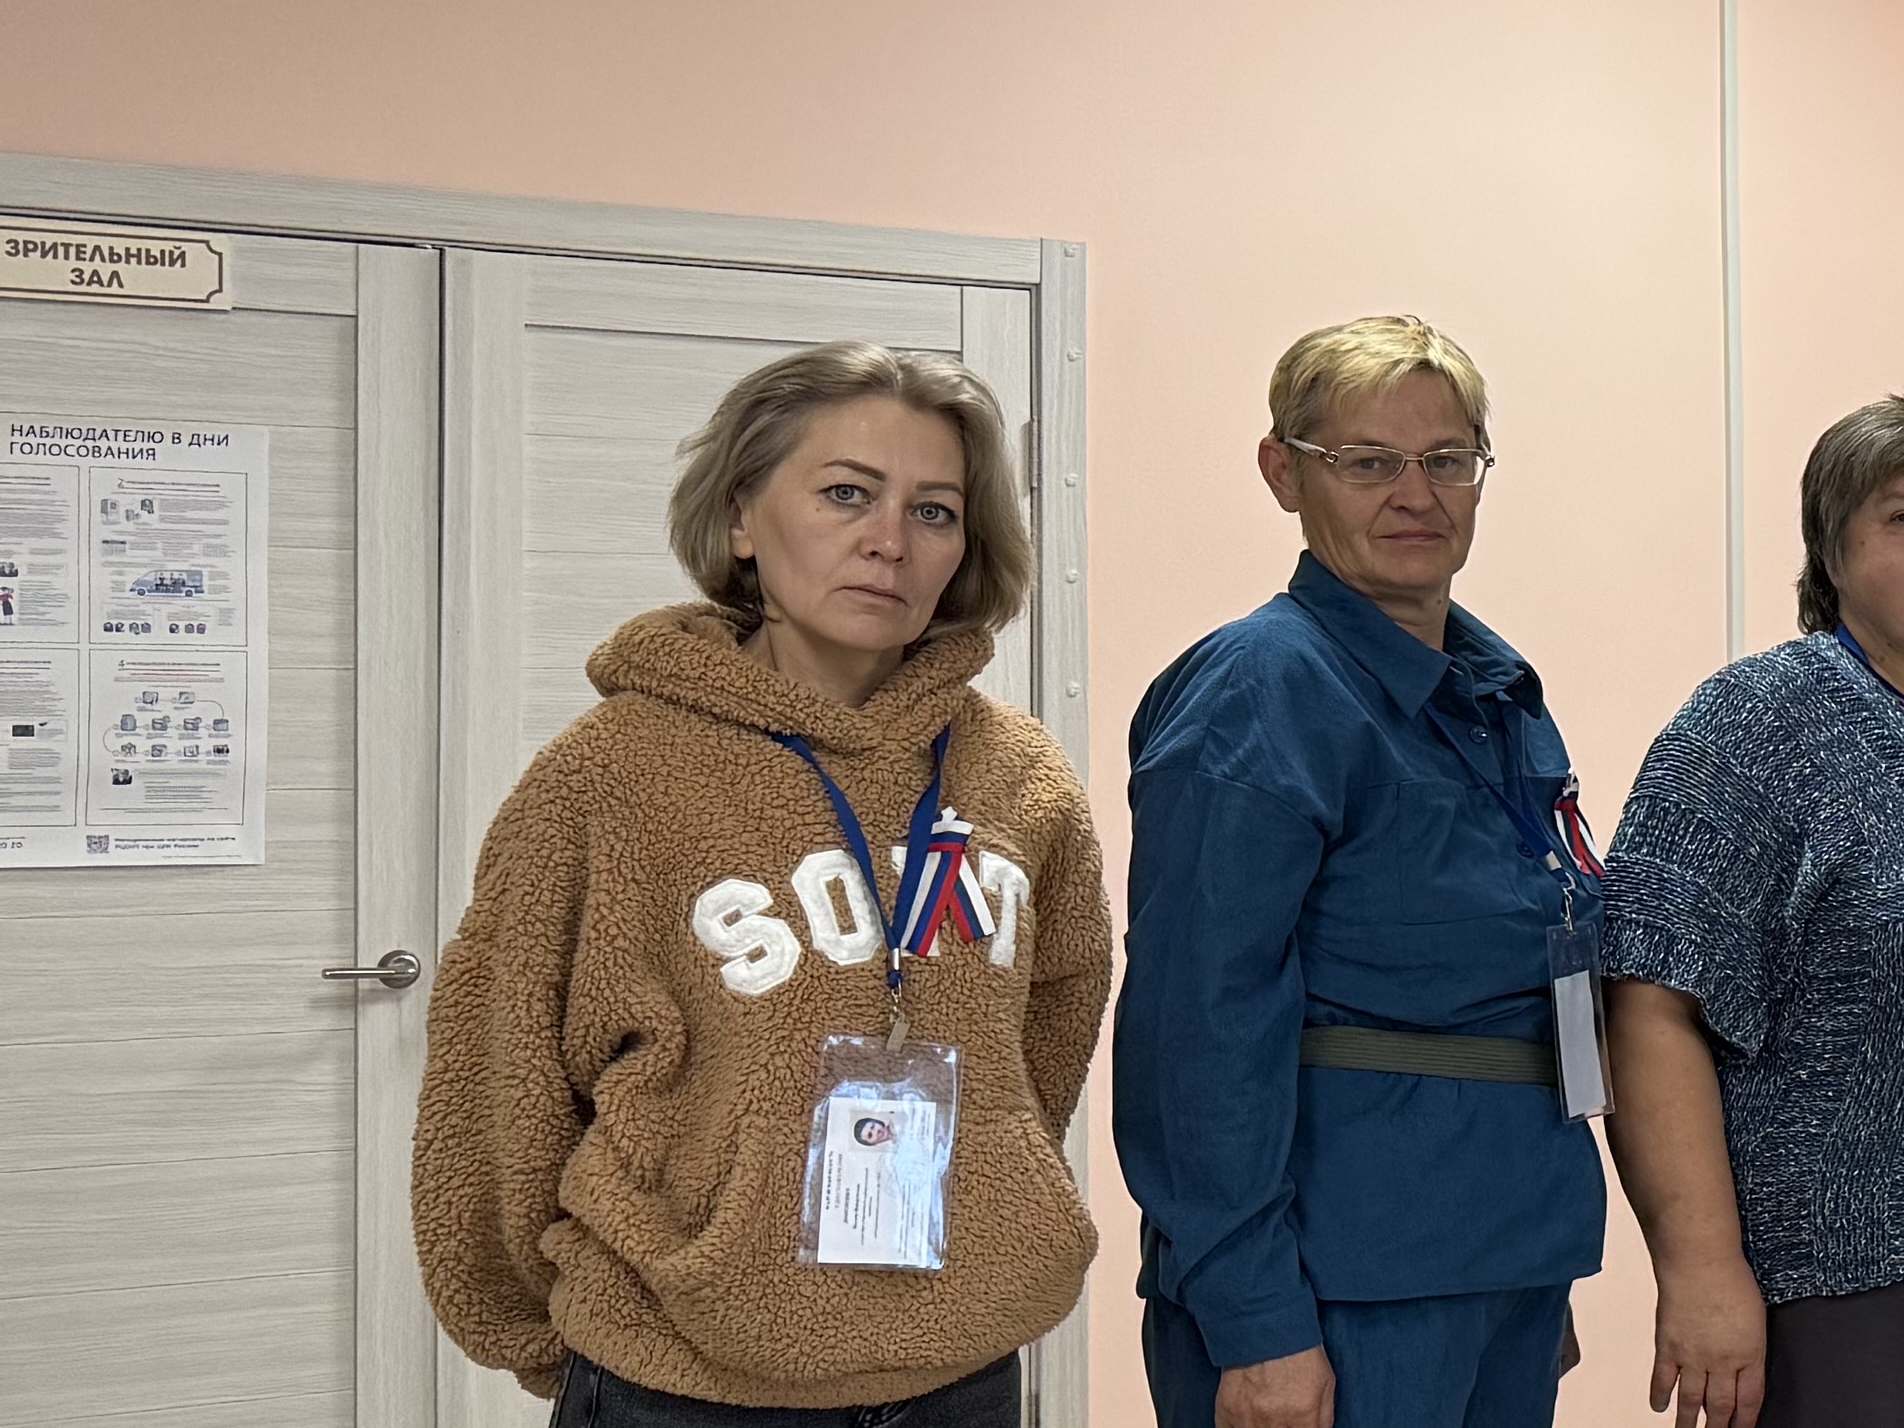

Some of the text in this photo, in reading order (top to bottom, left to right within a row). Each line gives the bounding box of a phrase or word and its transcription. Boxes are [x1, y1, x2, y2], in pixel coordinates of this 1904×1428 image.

[4, 238, 187, 268] ЗРИТЕЛЬНЫЙ
[69, 267, 125, 289] ЗАЛ
[10, 423, 230, 448] НАБЛЮДАТЕЛЮ В ДНИ
[9, 441, 157, 461] ГОЛОСОВАНИЯ
